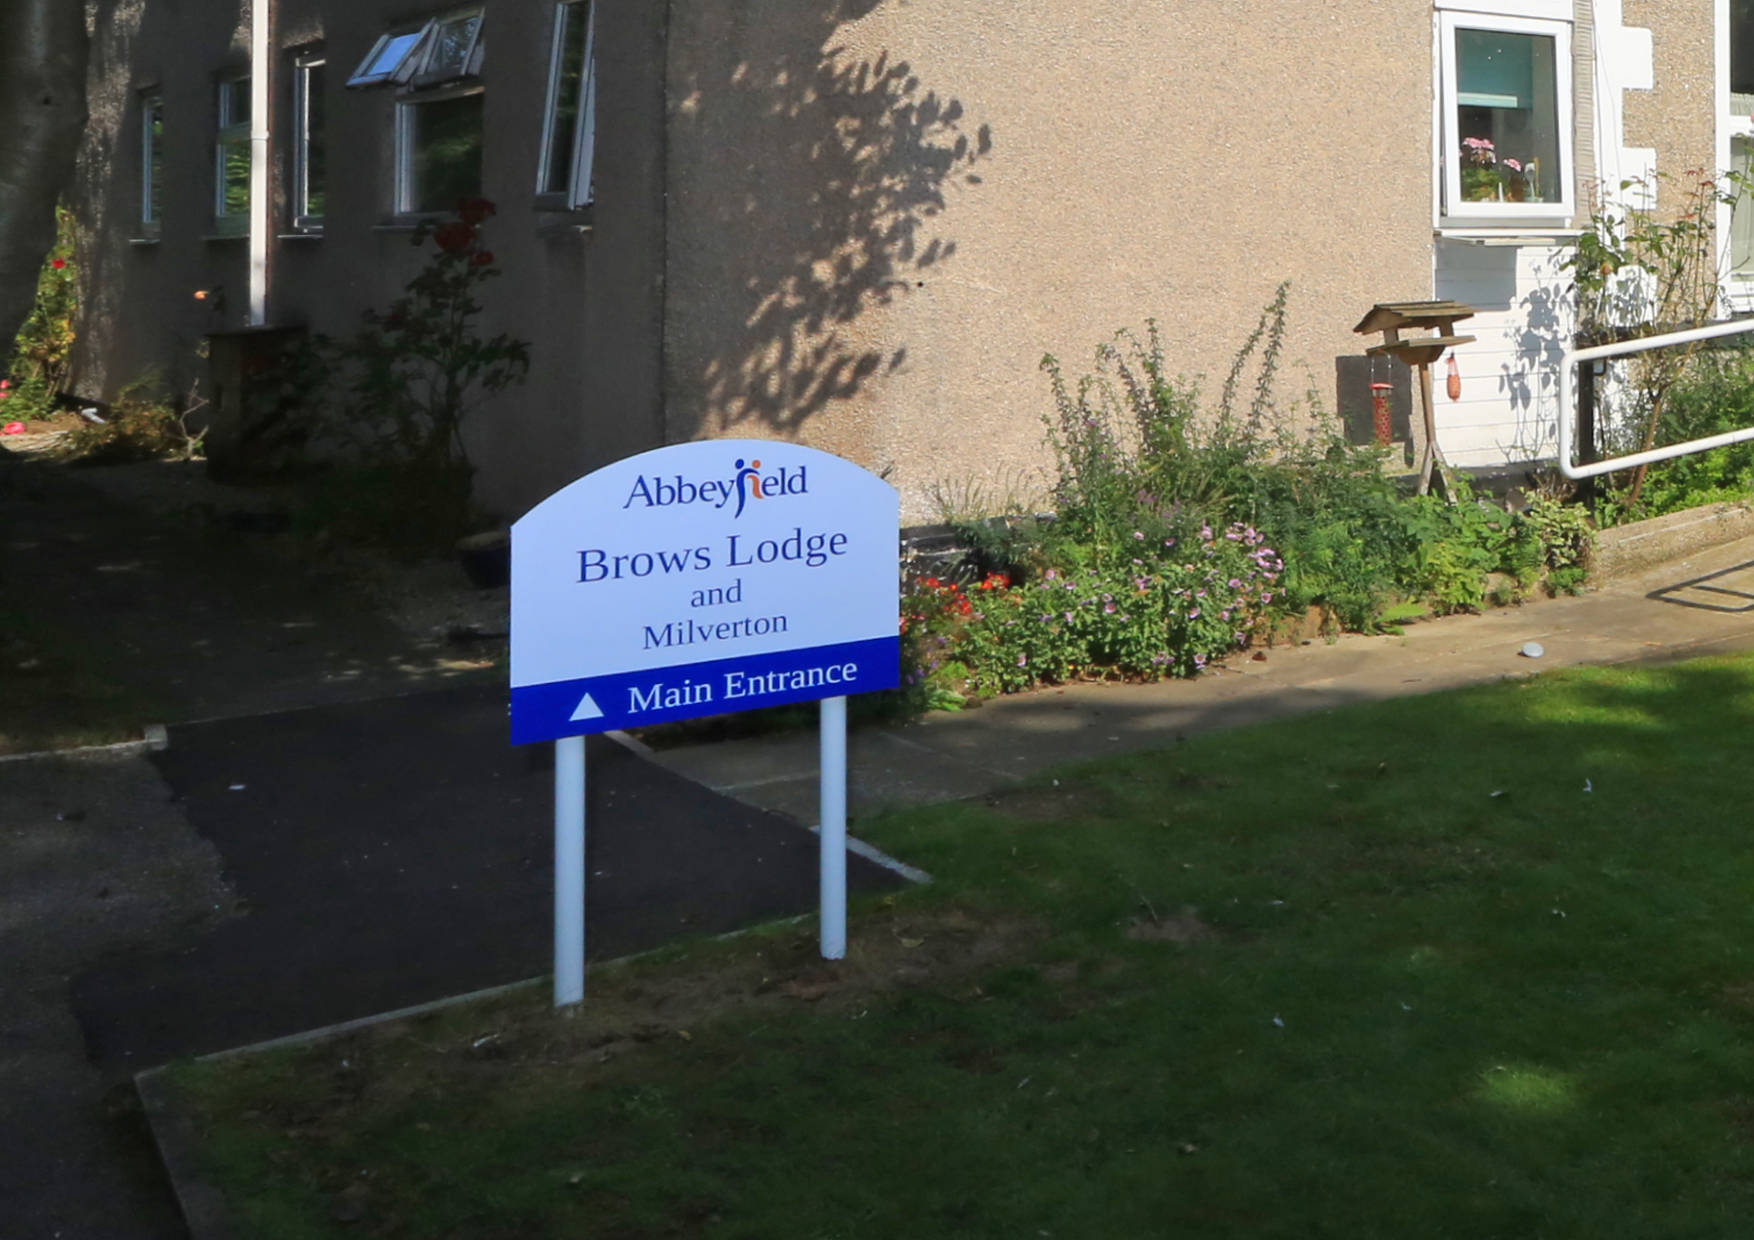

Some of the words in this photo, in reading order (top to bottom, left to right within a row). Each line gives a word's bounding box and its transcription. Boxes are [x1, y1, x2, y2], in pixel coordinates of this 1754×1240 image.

[623, 459, 808, 519] Abbeyfield
[576, 545, 711, 583] Brows
[726, 528, 848, 567] Lodge
[690, 579, 742, 607] and
[642, 615, 788, 649] Milverton
[627, 679, 712, 714] Main
[724, 662, 858, 699] Entrance
